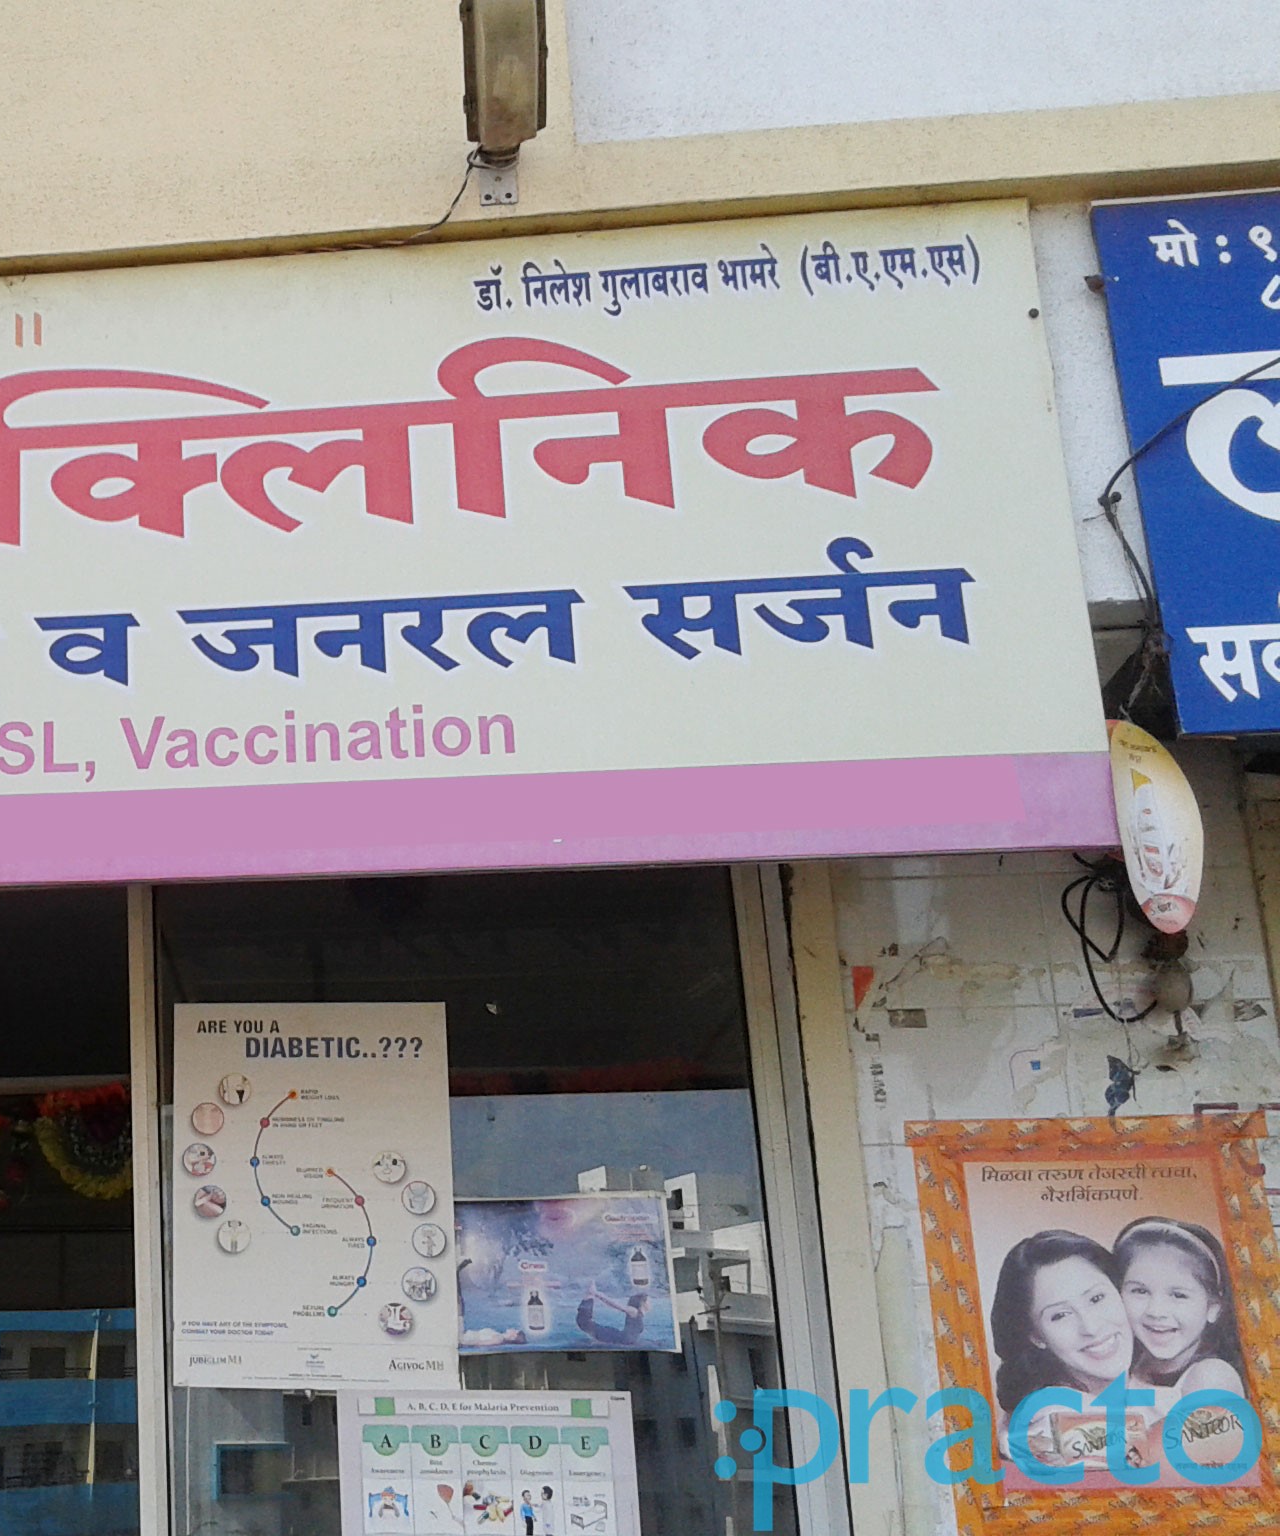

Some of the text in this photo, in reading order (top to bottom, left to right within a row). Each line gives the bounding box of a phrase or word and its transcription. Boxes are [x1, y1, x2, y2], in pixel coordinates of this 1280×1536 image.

[1148, 219, 1199, 267] मो
[521, 259, 591, 307] निलेश
[600, 262, 708, 316] गुलाबराव
[718, 243, 780, 291] भामरे
[34, 612, 140, 687] व
[177, 588, 585, 679] जनरल
[622, 537, 976, 663] सर्जन
[120, 703, 517, 770] Vaccination
[197, 1020, 280, 1034] ARE YOU A
[245, 1036, 423, 1058] DIABETIC..???
[475, 1403, 508, 1411] Malaria
[510, 1404, 560, 1412] Prevention
[381, 1434, 393, 1448] A
[430, 1434, 441, 1448] B
[479, 1434, 490, 1449] C
[529, 1435, 542, 1450] D
[581, 1436, 591, 1450] E
